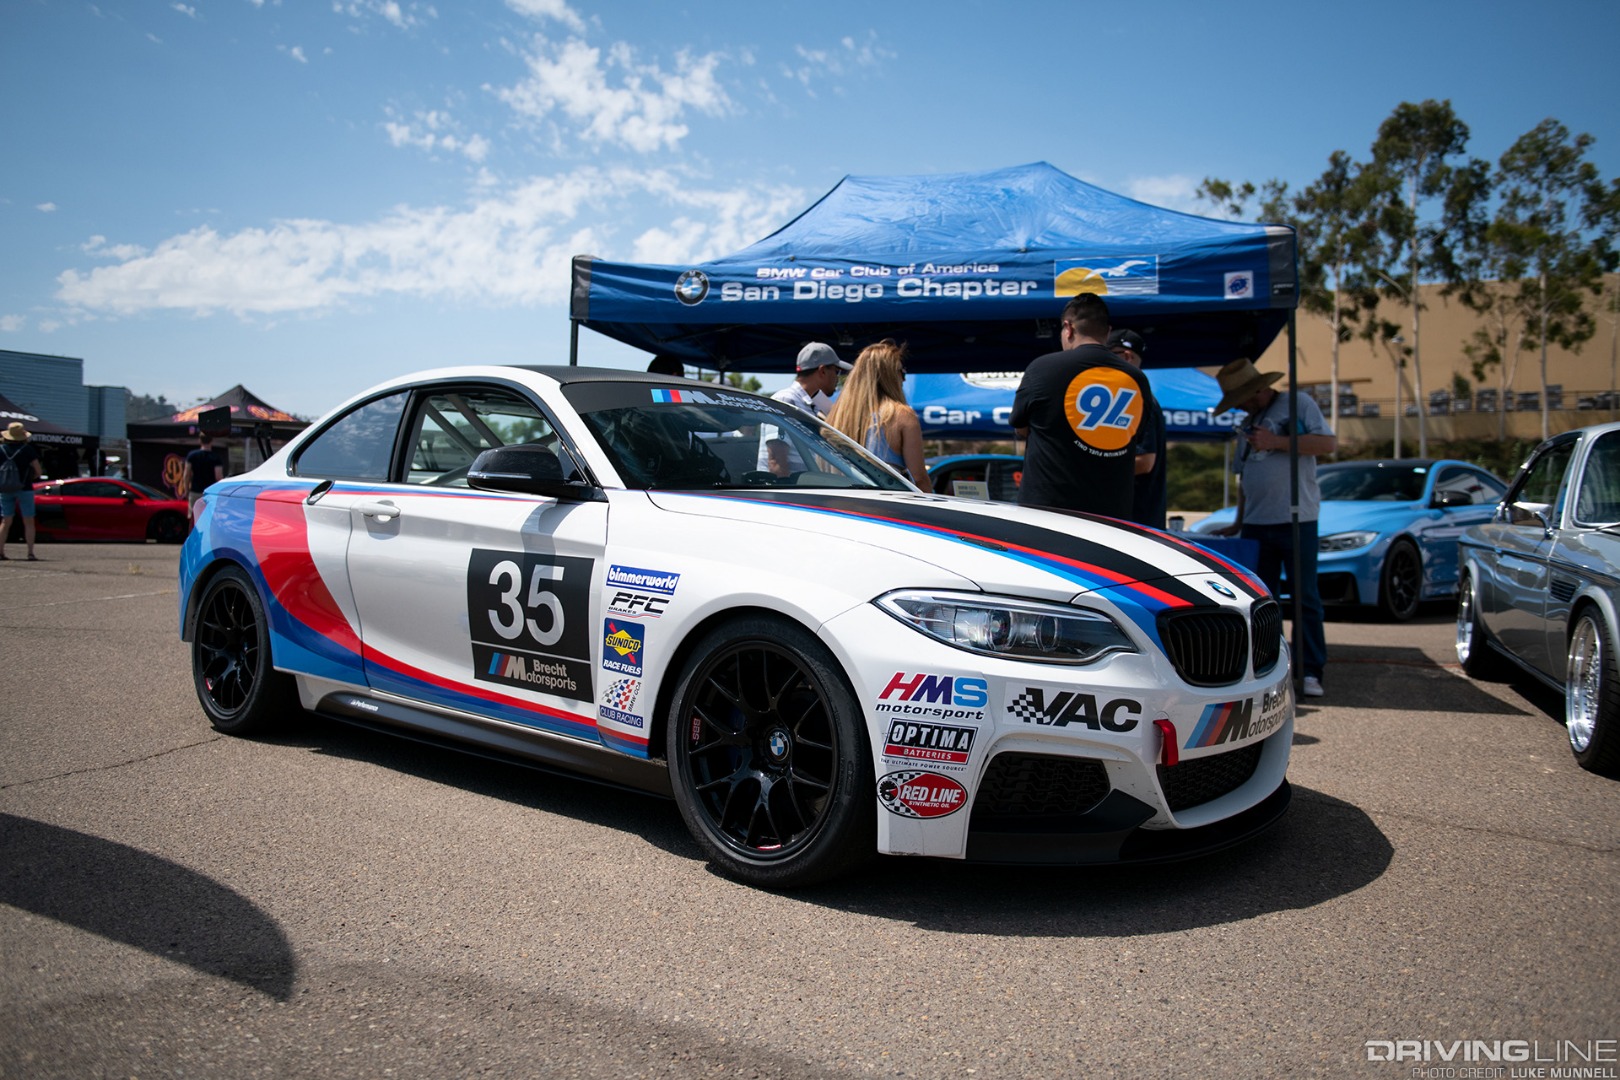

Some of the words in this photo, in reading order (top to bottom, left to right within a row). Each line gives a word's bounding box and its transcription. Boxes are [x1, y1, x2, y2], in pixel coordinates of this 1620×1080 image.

[757, 268, 807, 278] BMW
[811, 268, 843, 278] Car
[850, 266, 891, 276] Club
[897, 263, 916, 274] of
[922, 263, 999, 274] America
[721, 282, 779, 302] San
[793, 281, 884, 303] Diego
[897, 277, 1037, 300] Chapter
[923, 406, 980, 425] Car
[31, 433, 83, 444] NITRONIC.COM
[1073, 439, 1088, 451] ONLY
[1088, 448, 1103, 457] FUEL
[609, 567, 678, 589] bimmerworld
[488, 560, 565, 646] 35
[608, 606, 637, 614] BRAKES
[611, 592, 670, 614] PFC
[607, 635, 640, 651] SUNOCO
[533, 659, 568, 677] Brecht
[603, 659, 621, 672] RACE
[620, 663, 642, 675] FUELS
[879, 672, 988, 708] HMS
[600, 707, 616, 721] CLUB
[616, 711, 642, 727] RACING
[875, 703, 985, 720] motorsport
[1026, 688, 1142, 733] VAC
[892, 725, 969, 750] OPTIMA
[903, 748, 952, 760] BATTERIES
[891, 759, 918, 767] ULTIMATE
[900, 785, 929, 800] RED
[930, 788, 962, 804] LINE
[908, 800, 940, 808] SYNTHETIC
